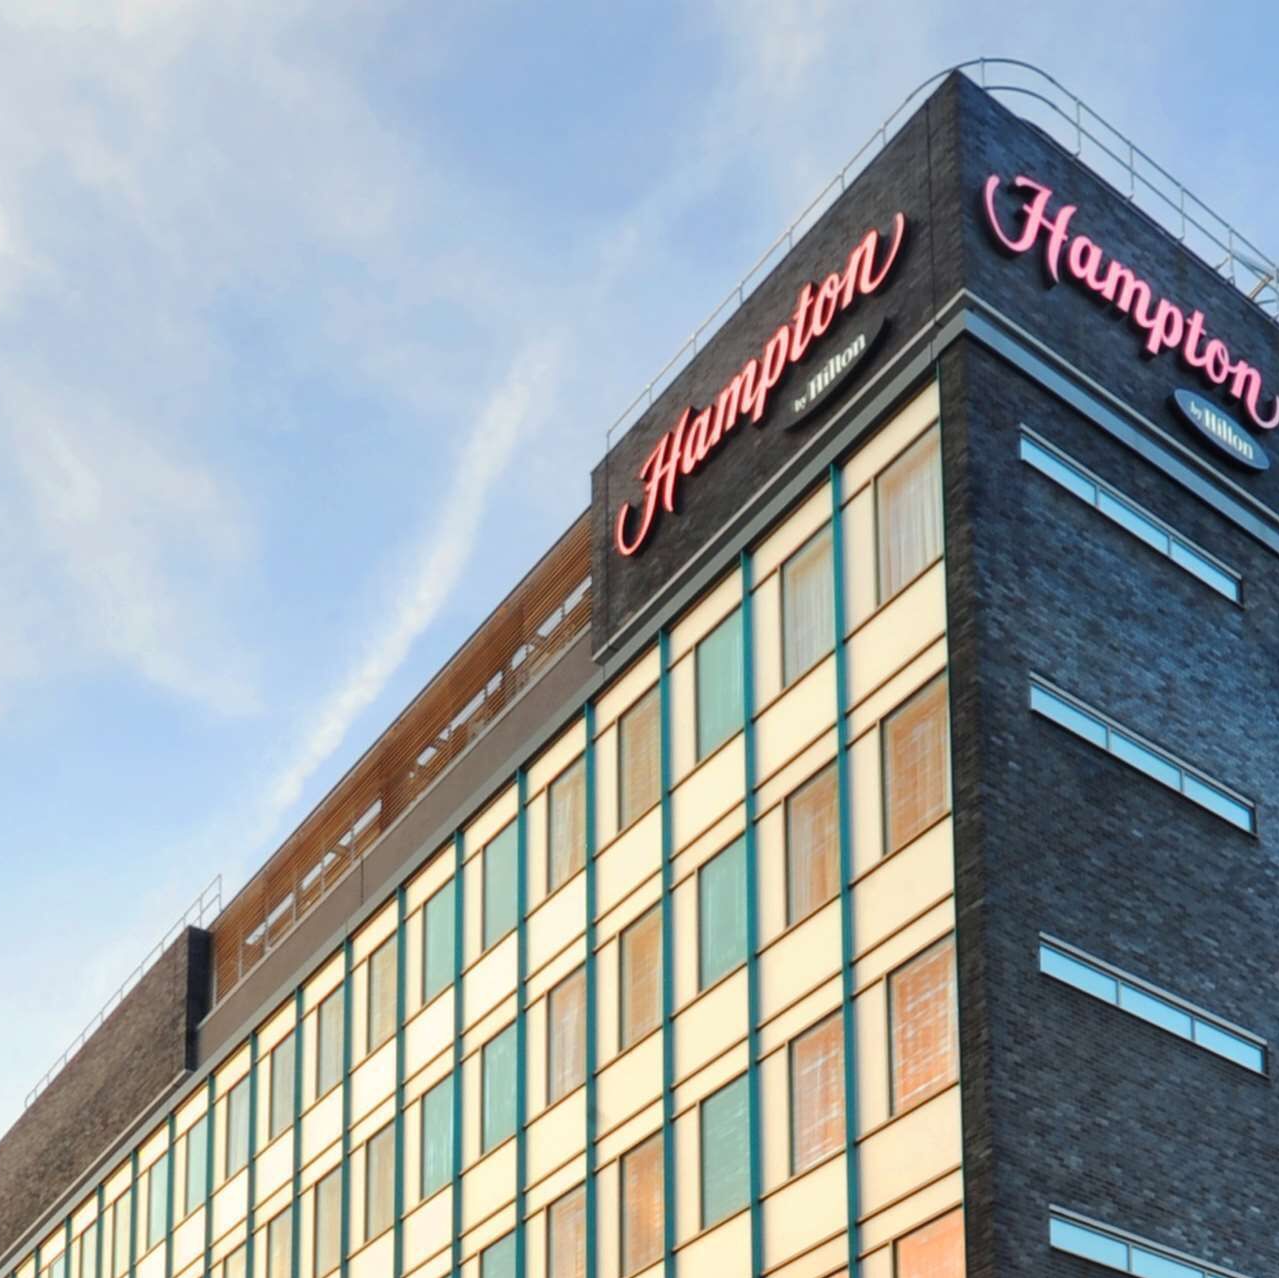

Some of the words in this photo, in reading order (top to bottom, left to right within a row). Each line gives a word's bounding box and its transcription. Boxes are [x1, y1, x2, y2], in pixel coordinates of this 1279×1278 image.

[615, 211, 907, 557] Hampton
[808, 334, 866, 401] Hilton
[1204, 407, 1254, 460] Hilton
